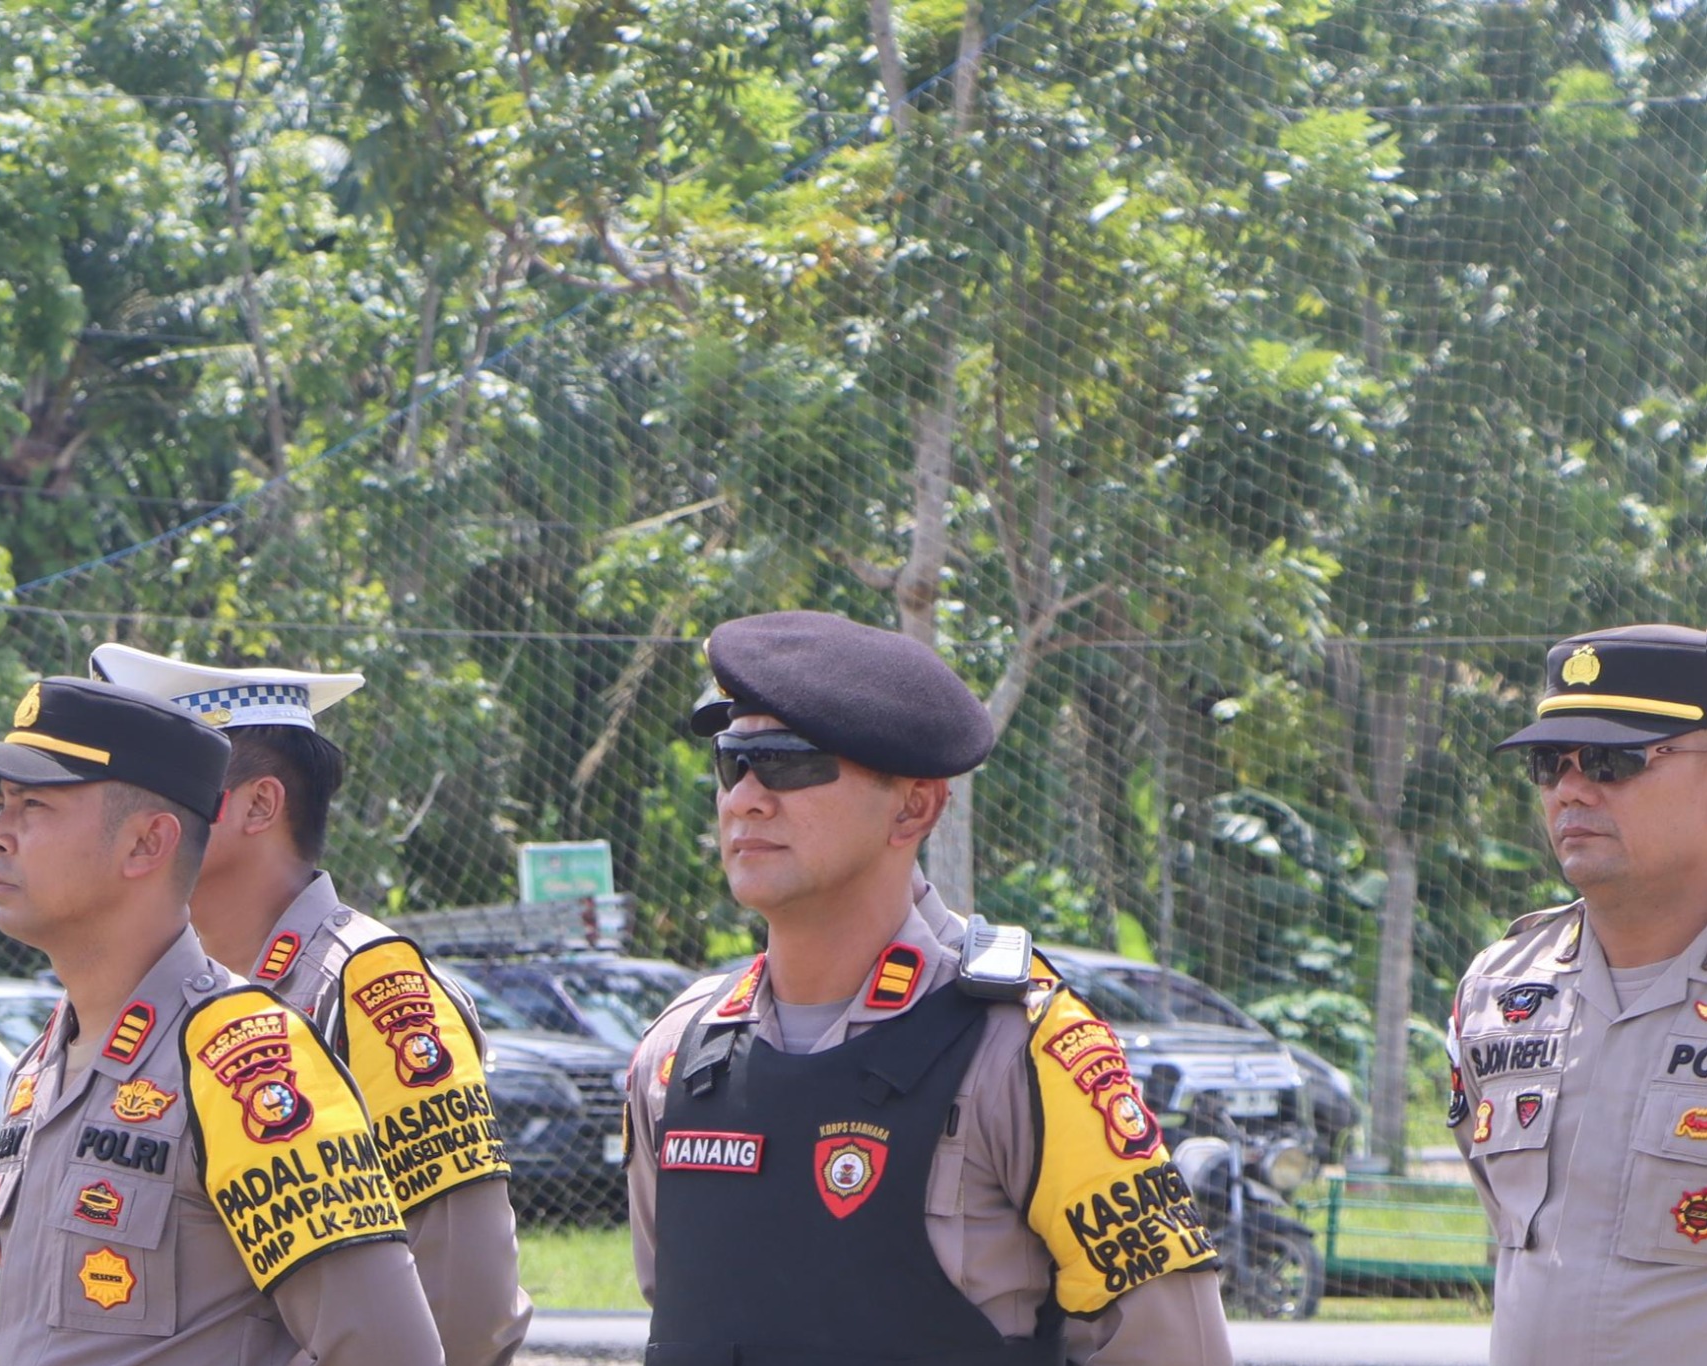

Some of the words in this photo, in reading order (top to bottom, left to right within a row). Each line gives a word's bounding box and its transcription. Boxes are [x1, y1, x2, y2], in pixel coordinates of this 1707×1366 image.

[360, 973, 422, 1000] POLRES
[367, 986, 400, 1010] ROKAN
[207, 1014, 280, 1056] POLRES
[380, 1004, 430, 1028] RIAU
[210, 1030, 251, 1063] ROKAN
[250, 1023, 282, 1038] HULU
[224, 1047, 284, 1078] RIAU
[1082, 1058, 1124, 1084] RIAU
[373, 1083, 489, 1157] KASATGAS
[819, 1121, 849, 1138] KORPS
[76, 1126, 171, 1176] POLRI
[665, 1138, 757, 1166] NANANG
[216, 1148, 318, 1227] PADAL
[316, 1131, 382, 1177] PAM
[394, 1163, 443, 1201] OMP
[237, 1173, 391, 1253] KAMPANYE
[252, 1230, 296, 1275] OMP
[306, 1202, 399, 1240] LK-2024
[1104, 1245, 1171, 1294] OMP
